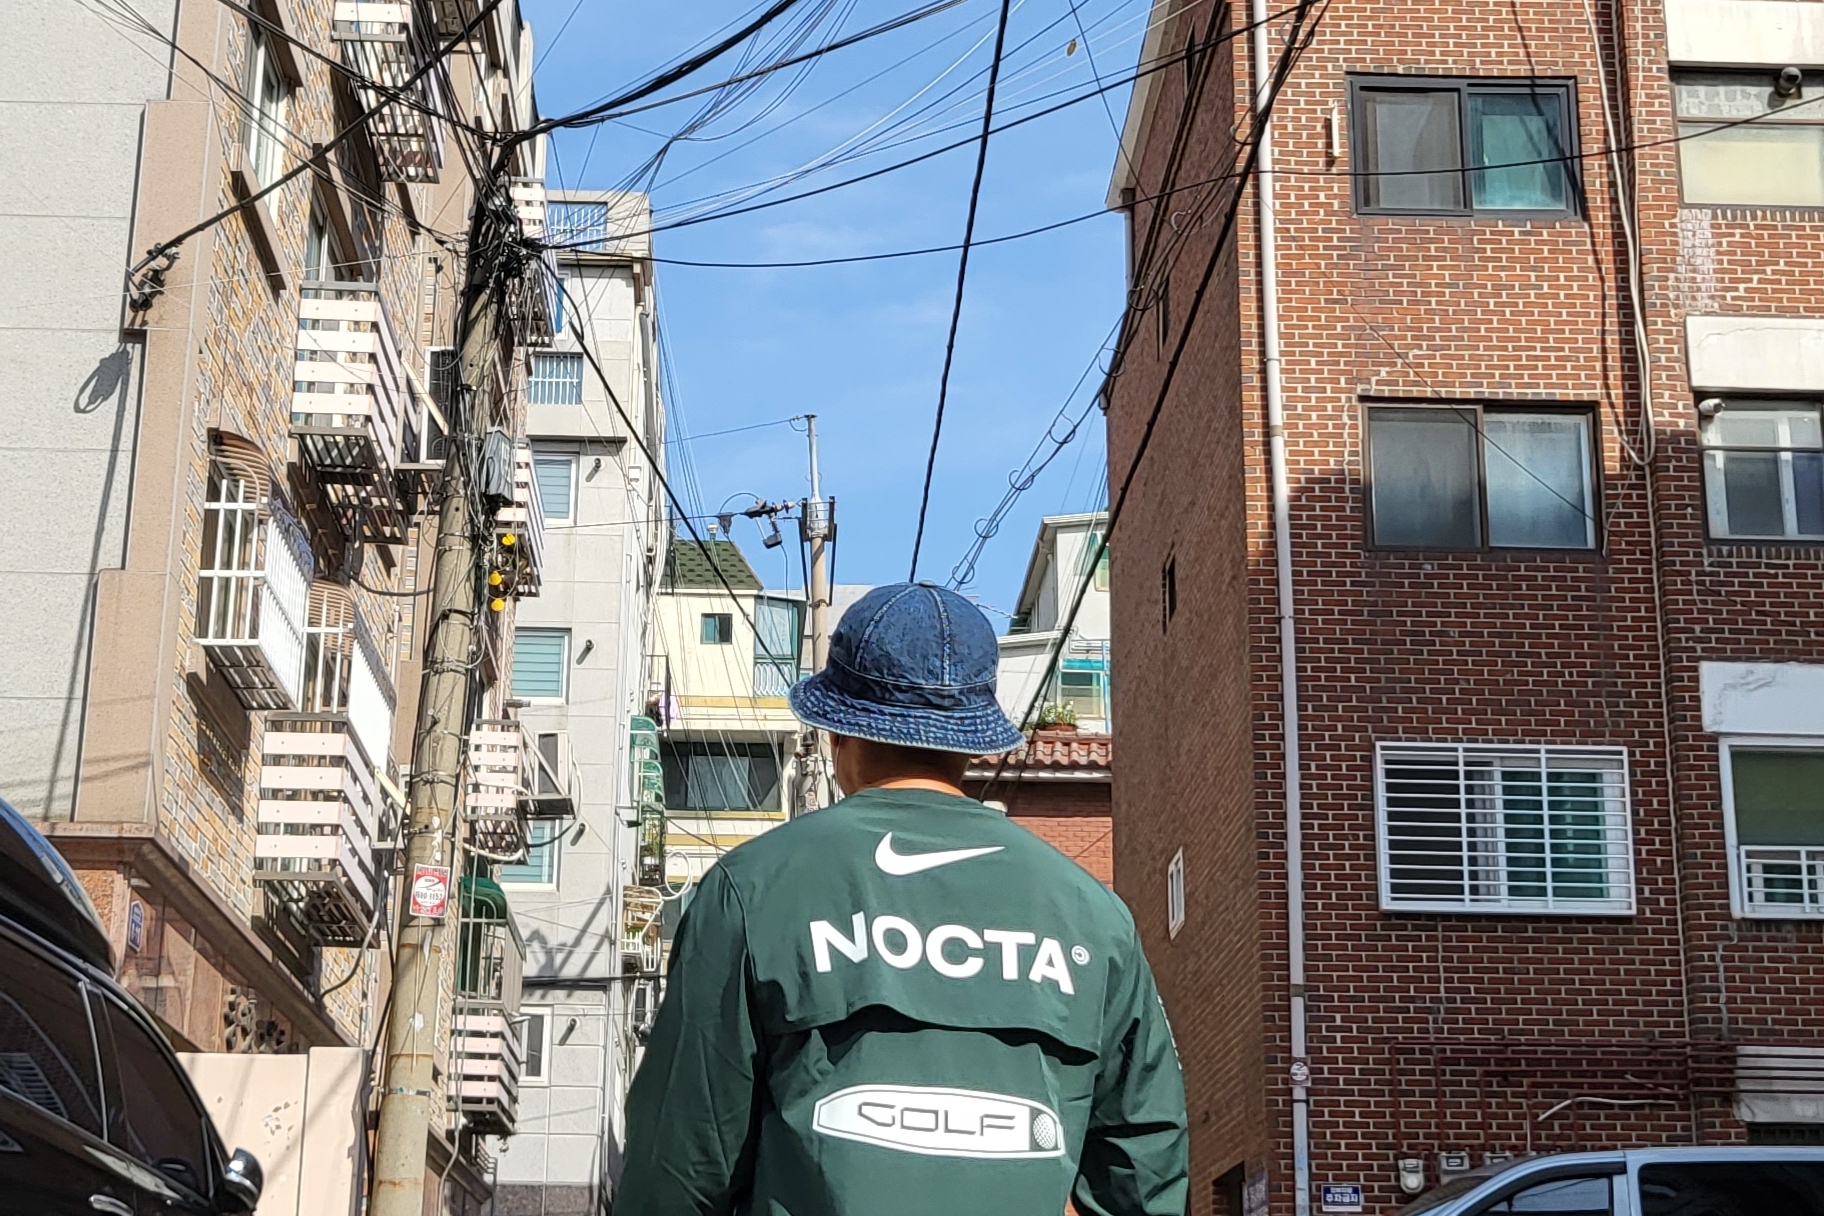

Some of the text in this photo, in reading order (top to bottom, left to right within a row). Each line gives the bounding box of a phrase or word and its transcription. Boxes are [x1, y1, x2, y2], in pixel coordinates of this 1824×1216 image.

[809, 910, 1075, 995] NOCTA
[857, 1101, 1016, 1137] GOLF
[1325, 1193, 1358, 1203] 주차금지
